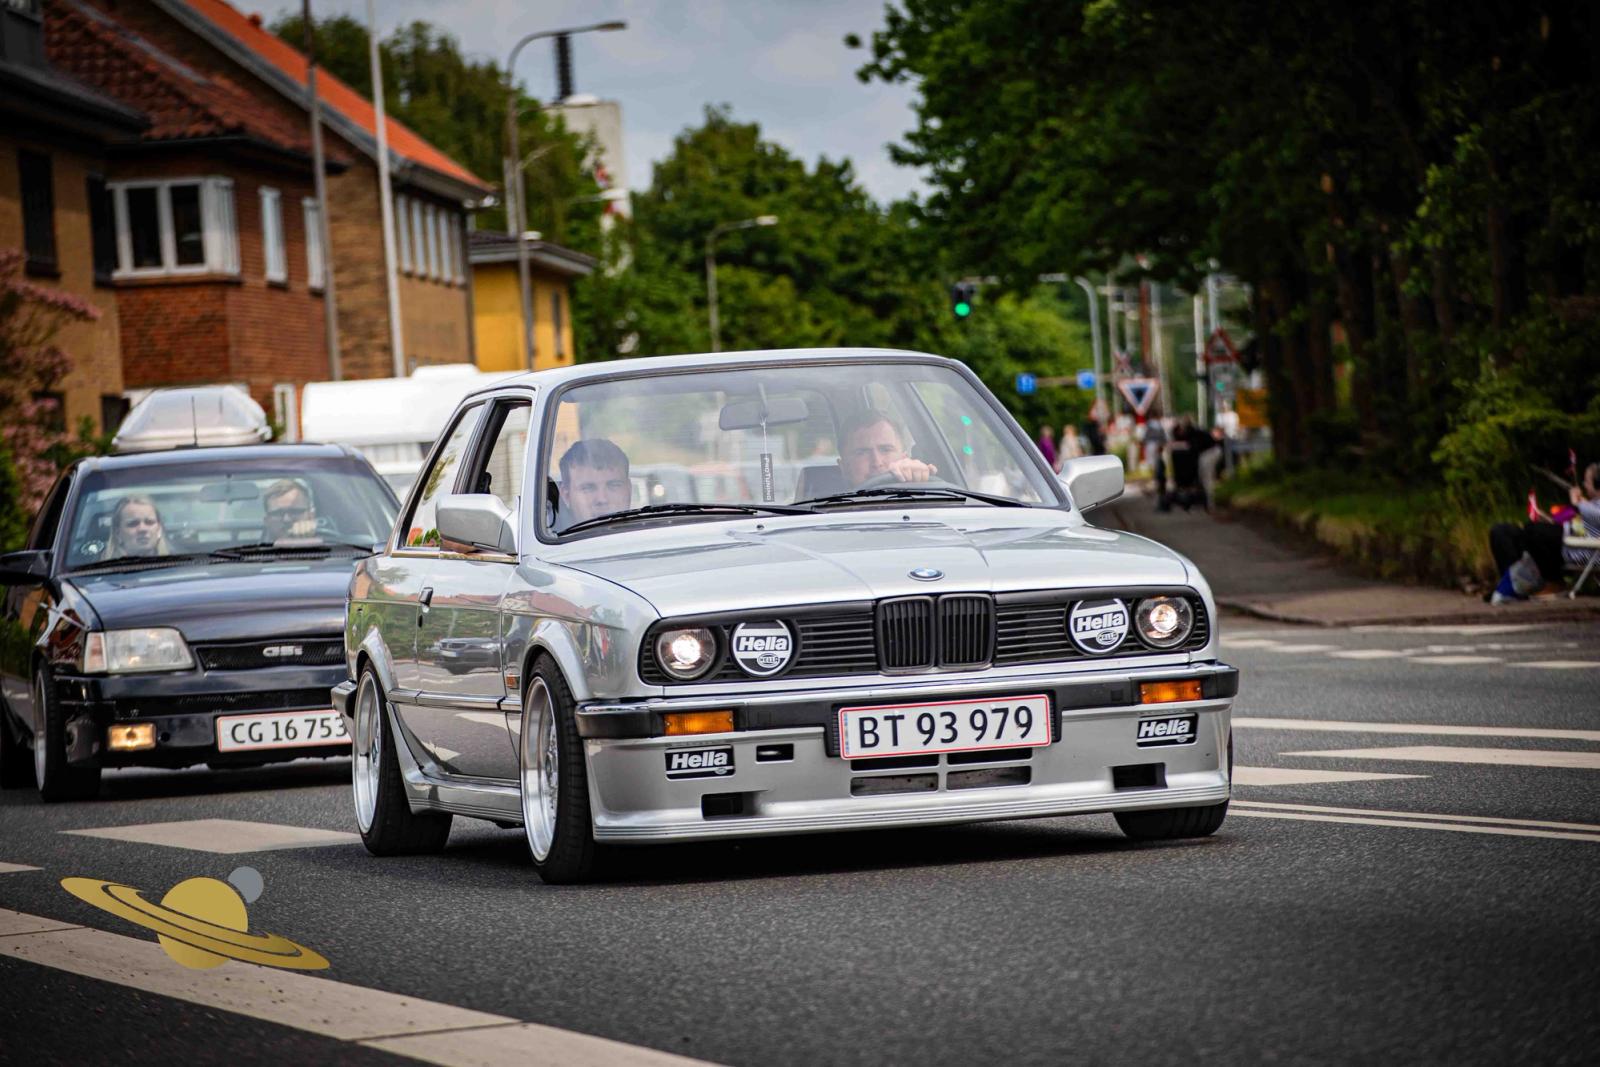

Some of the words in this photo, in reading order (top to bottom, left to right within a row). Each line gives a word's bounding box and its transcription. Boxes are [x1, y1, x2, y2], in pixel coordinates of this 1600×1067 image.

[1076, 613, 1124, 632] Hella
[739, 636, 788, 651] Hella
[231, 722, 263, 743] CG
[272, 719, 298, 741] 16
[304, 717, 348, 739] 753
[858, 715, 905, 748] BT
[916, 711, 958, 746] 93
[969, 705, 1033, 742] 979
[1138, 719, 1190, 737] Hella
[671, 751, 728, 769] Hella
